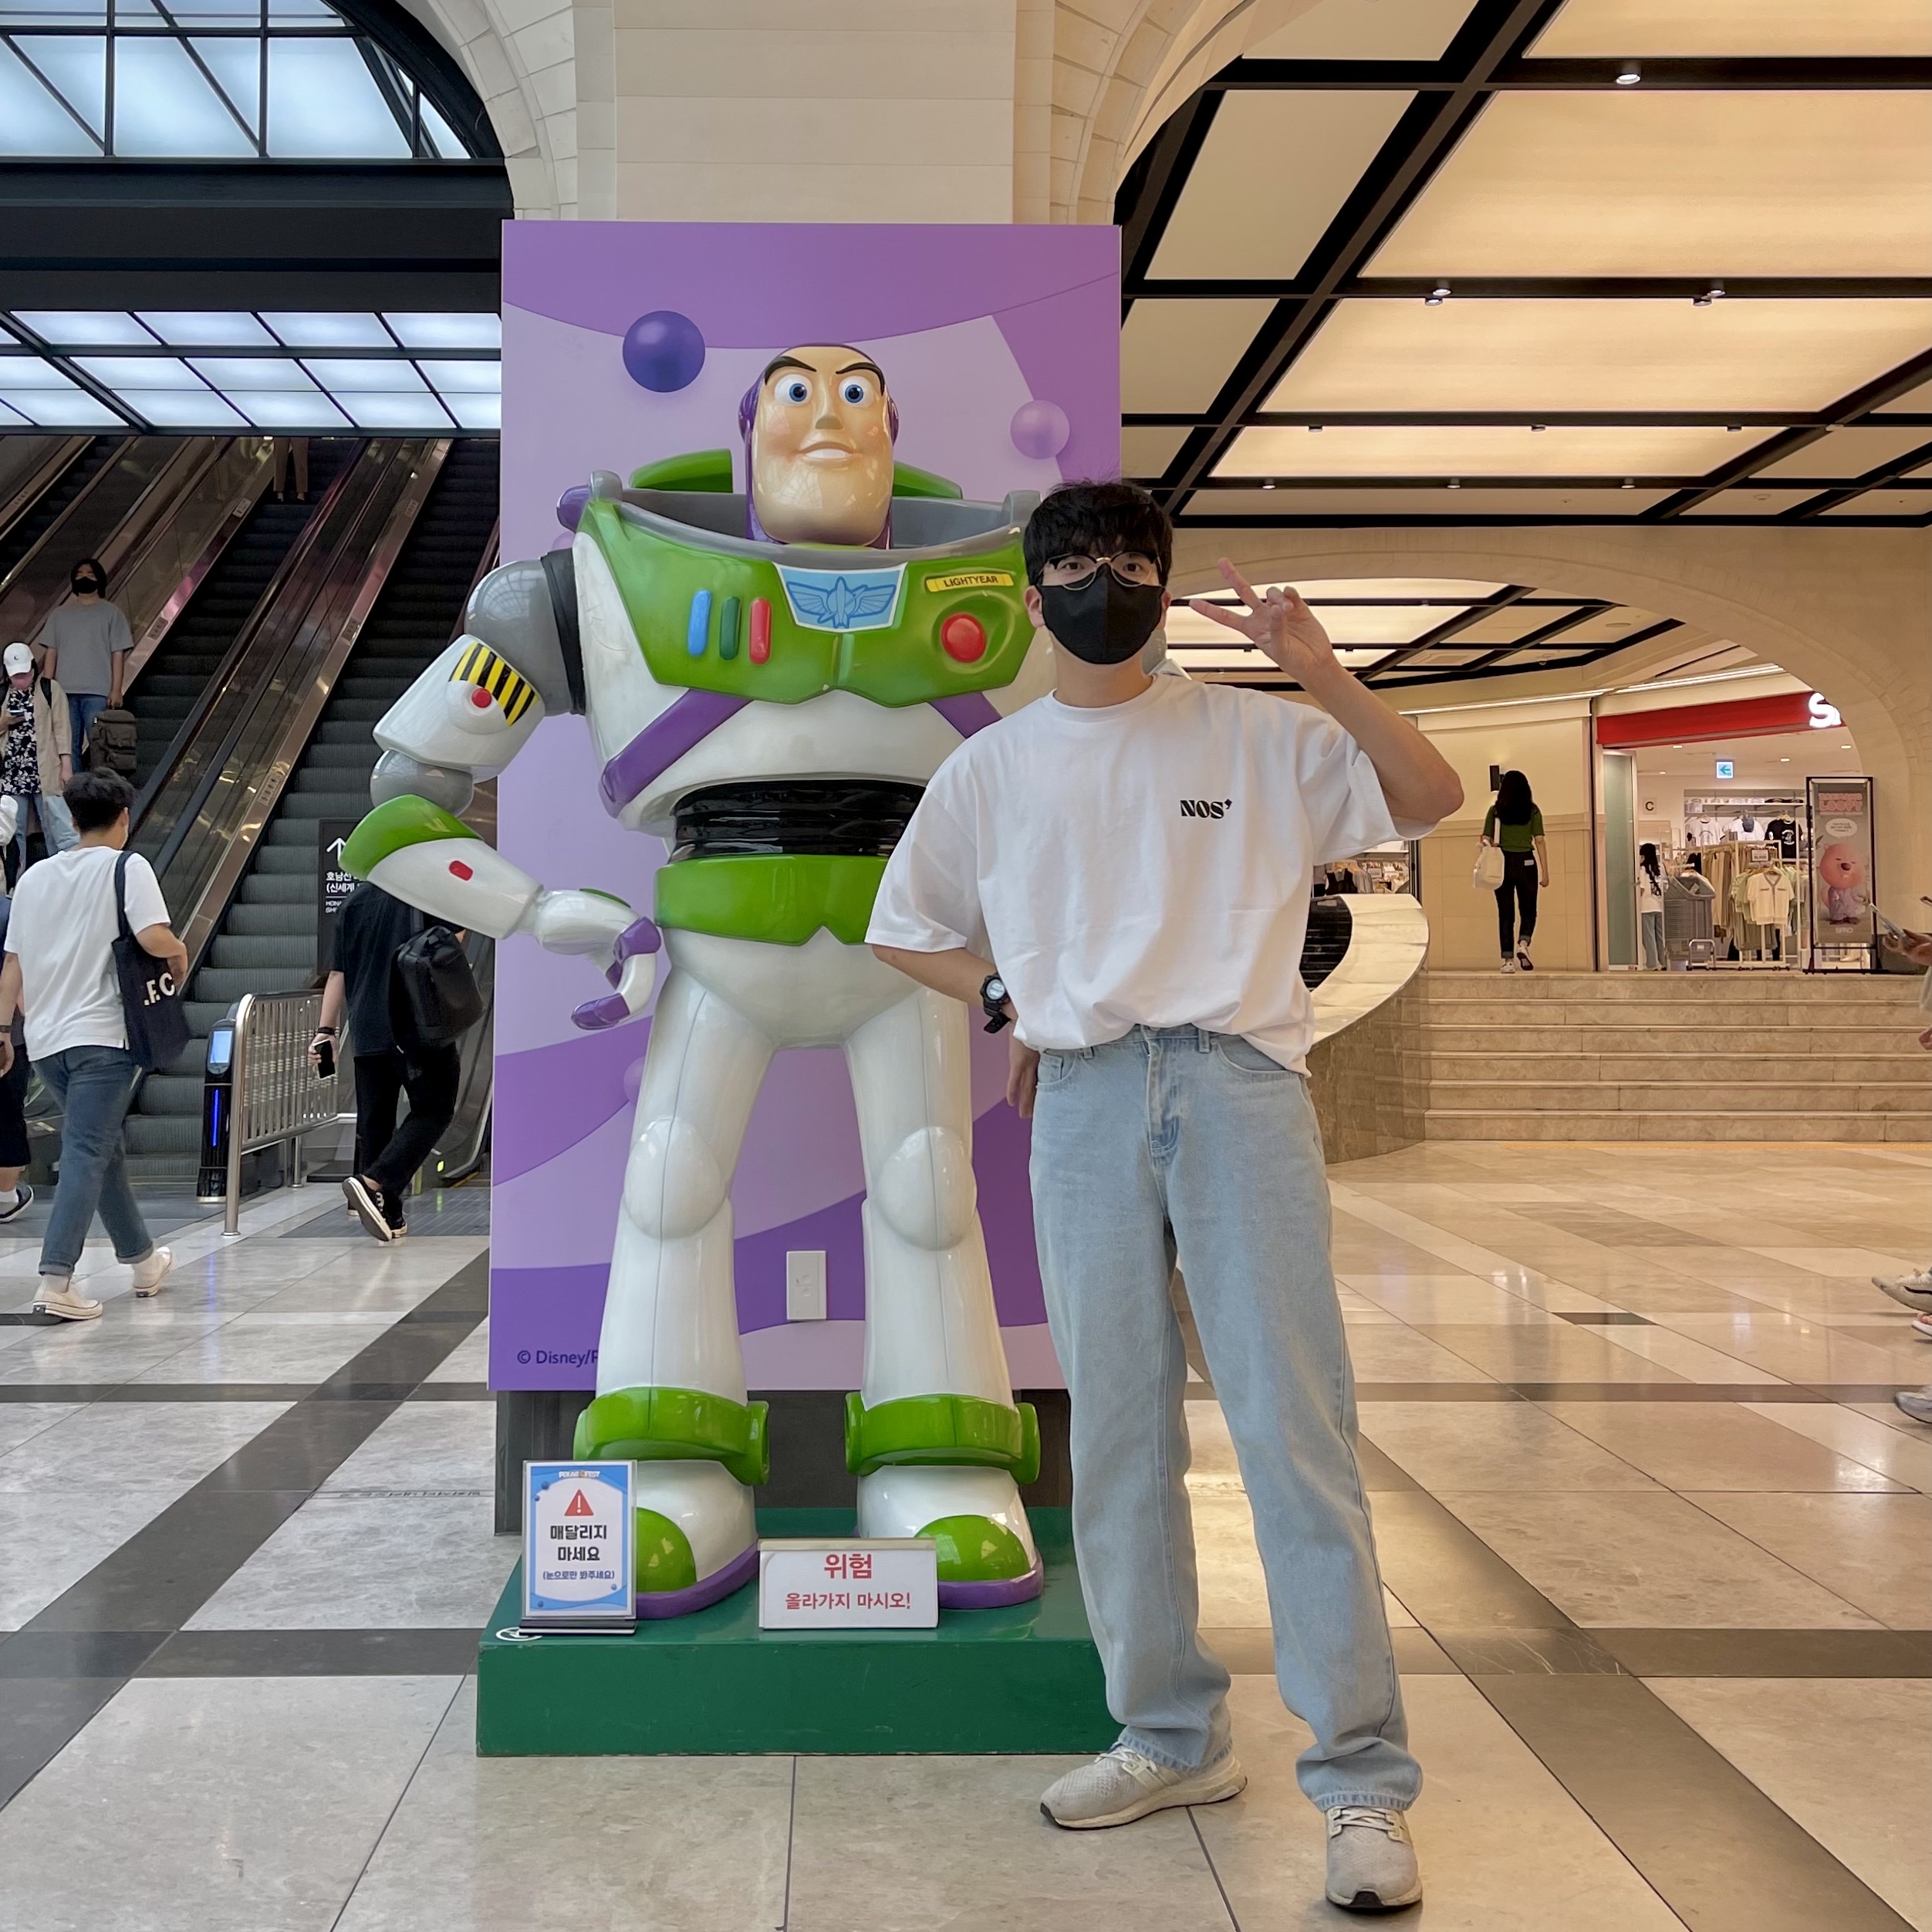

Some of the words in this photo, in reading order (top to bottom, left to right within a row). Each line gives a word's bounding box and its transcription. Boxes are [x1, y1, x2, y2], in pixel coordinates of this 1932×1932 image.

[943, 576, 998, 587] LIGHTYEAR
[1645, 801, 1654, 811] C
[1819, 800, 1862, 811] LOOPY
[550, 1525, 607, 1540] 매달리지
[557, 1546, 600, 1562] 마세요
[824, 1553, 872, 1579] 위험
[542, 1571, 577, 1580] (눈으로만
[579, 1570, 615, 1579] 봐주세요)
[785, 1593, 849, 1609] 올라가지
[857, 1593, 910, 1609] 마시오!
